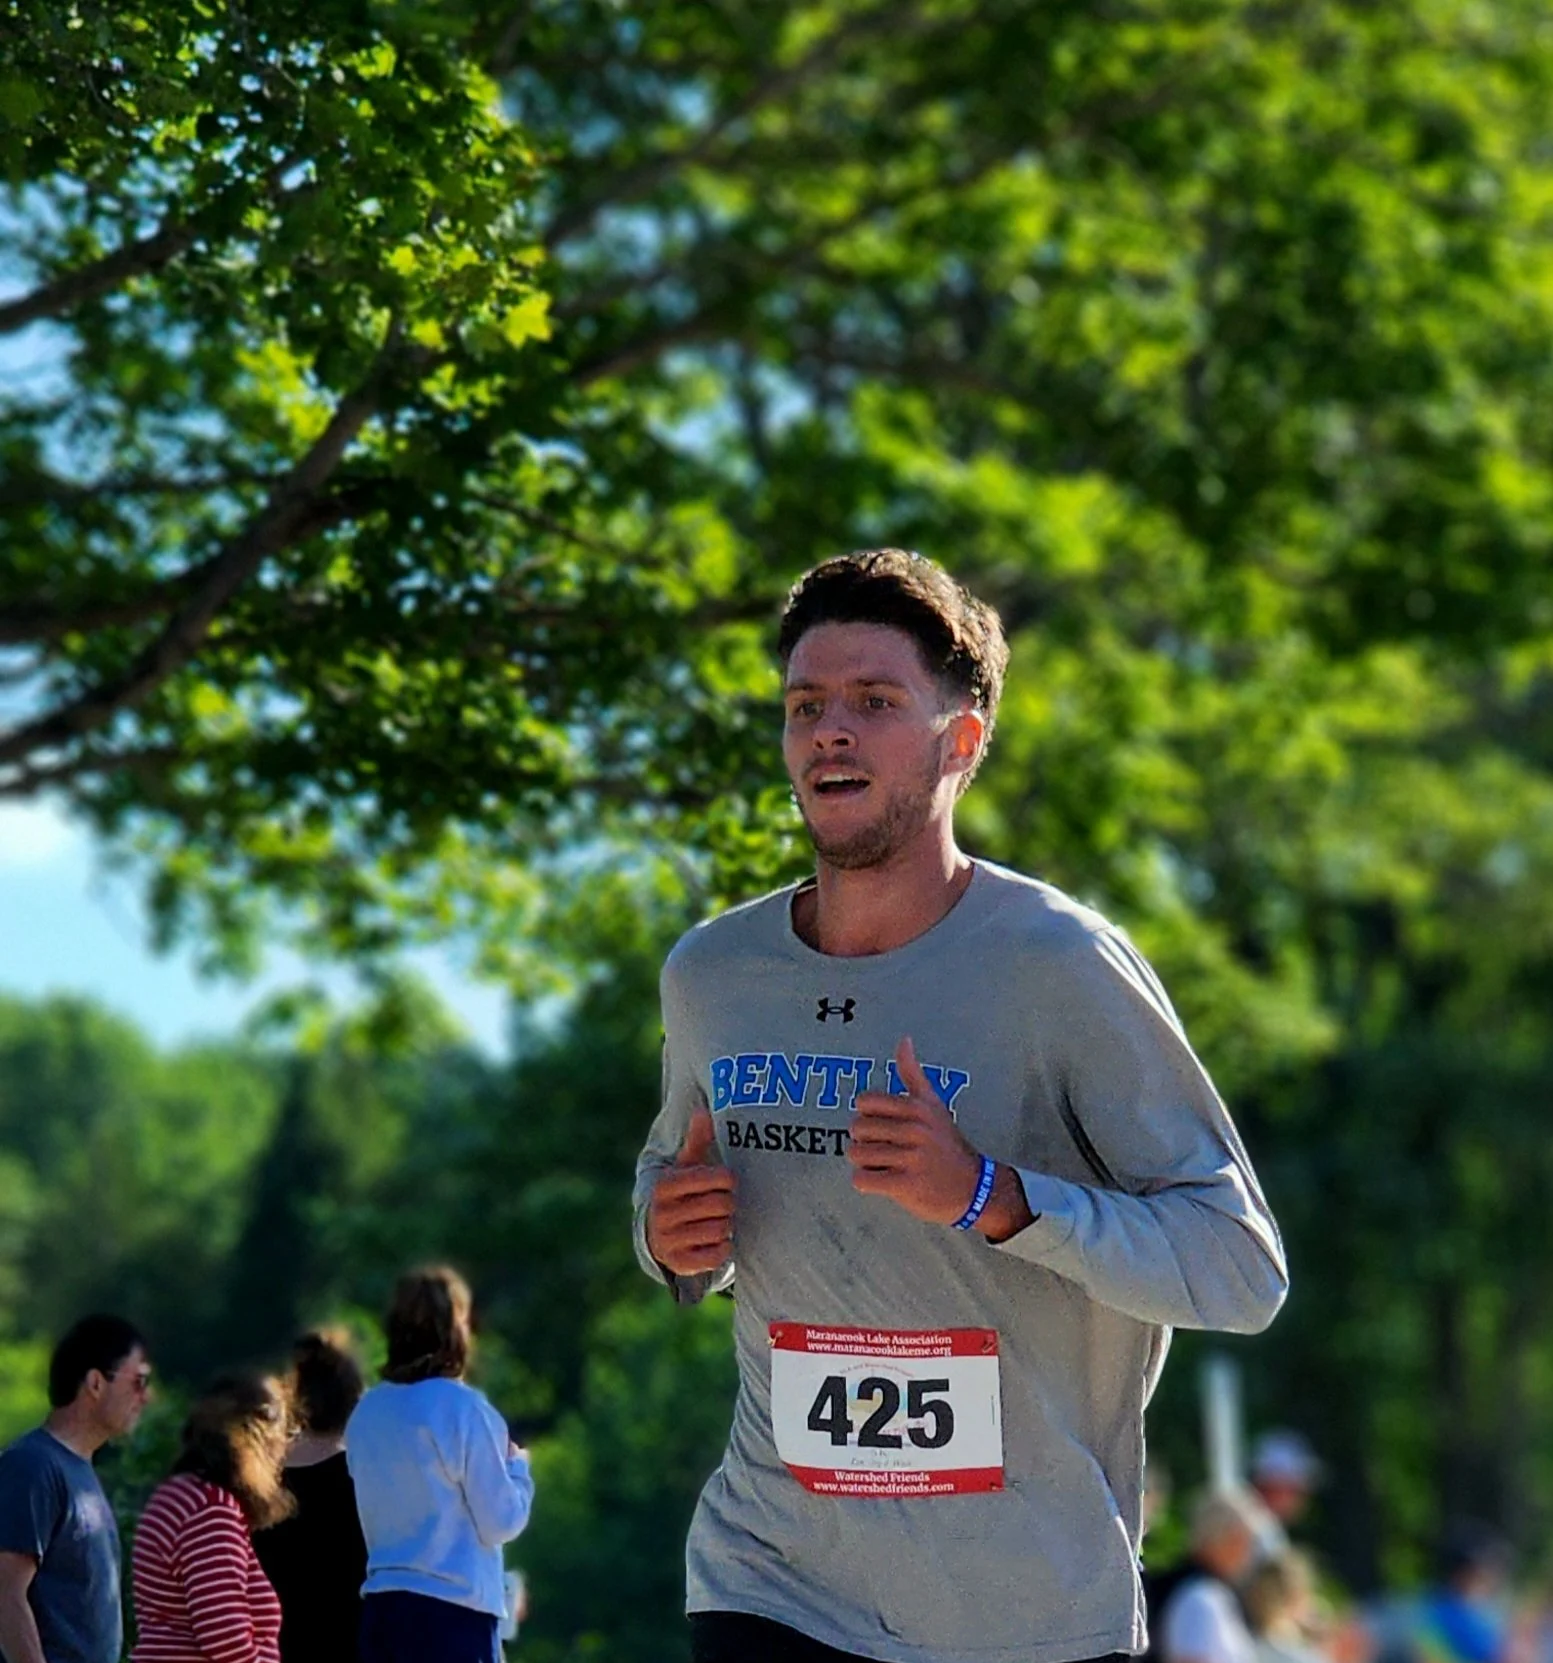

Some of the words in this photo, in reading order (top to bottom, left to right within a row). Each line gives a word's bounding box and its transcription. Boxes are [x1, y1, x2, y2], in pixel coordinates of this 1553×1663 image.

[972, 1185, 990, 1212] MADE
[806, 1329, 865, 1343] Maranacook
[867, 1333, 891, 1344] Lake
[891, 1334, 953, 1346] Association
[807, 1341, 952, 1357] www.maranacooklakeme.org
[807, 1375, 954, 1450] 425
[834, 1471, 888, 1483] Watershed
[890, 1472, 931, 1483] Friends
[813, 1481, 955, 1494] www.watershedfriends.com
